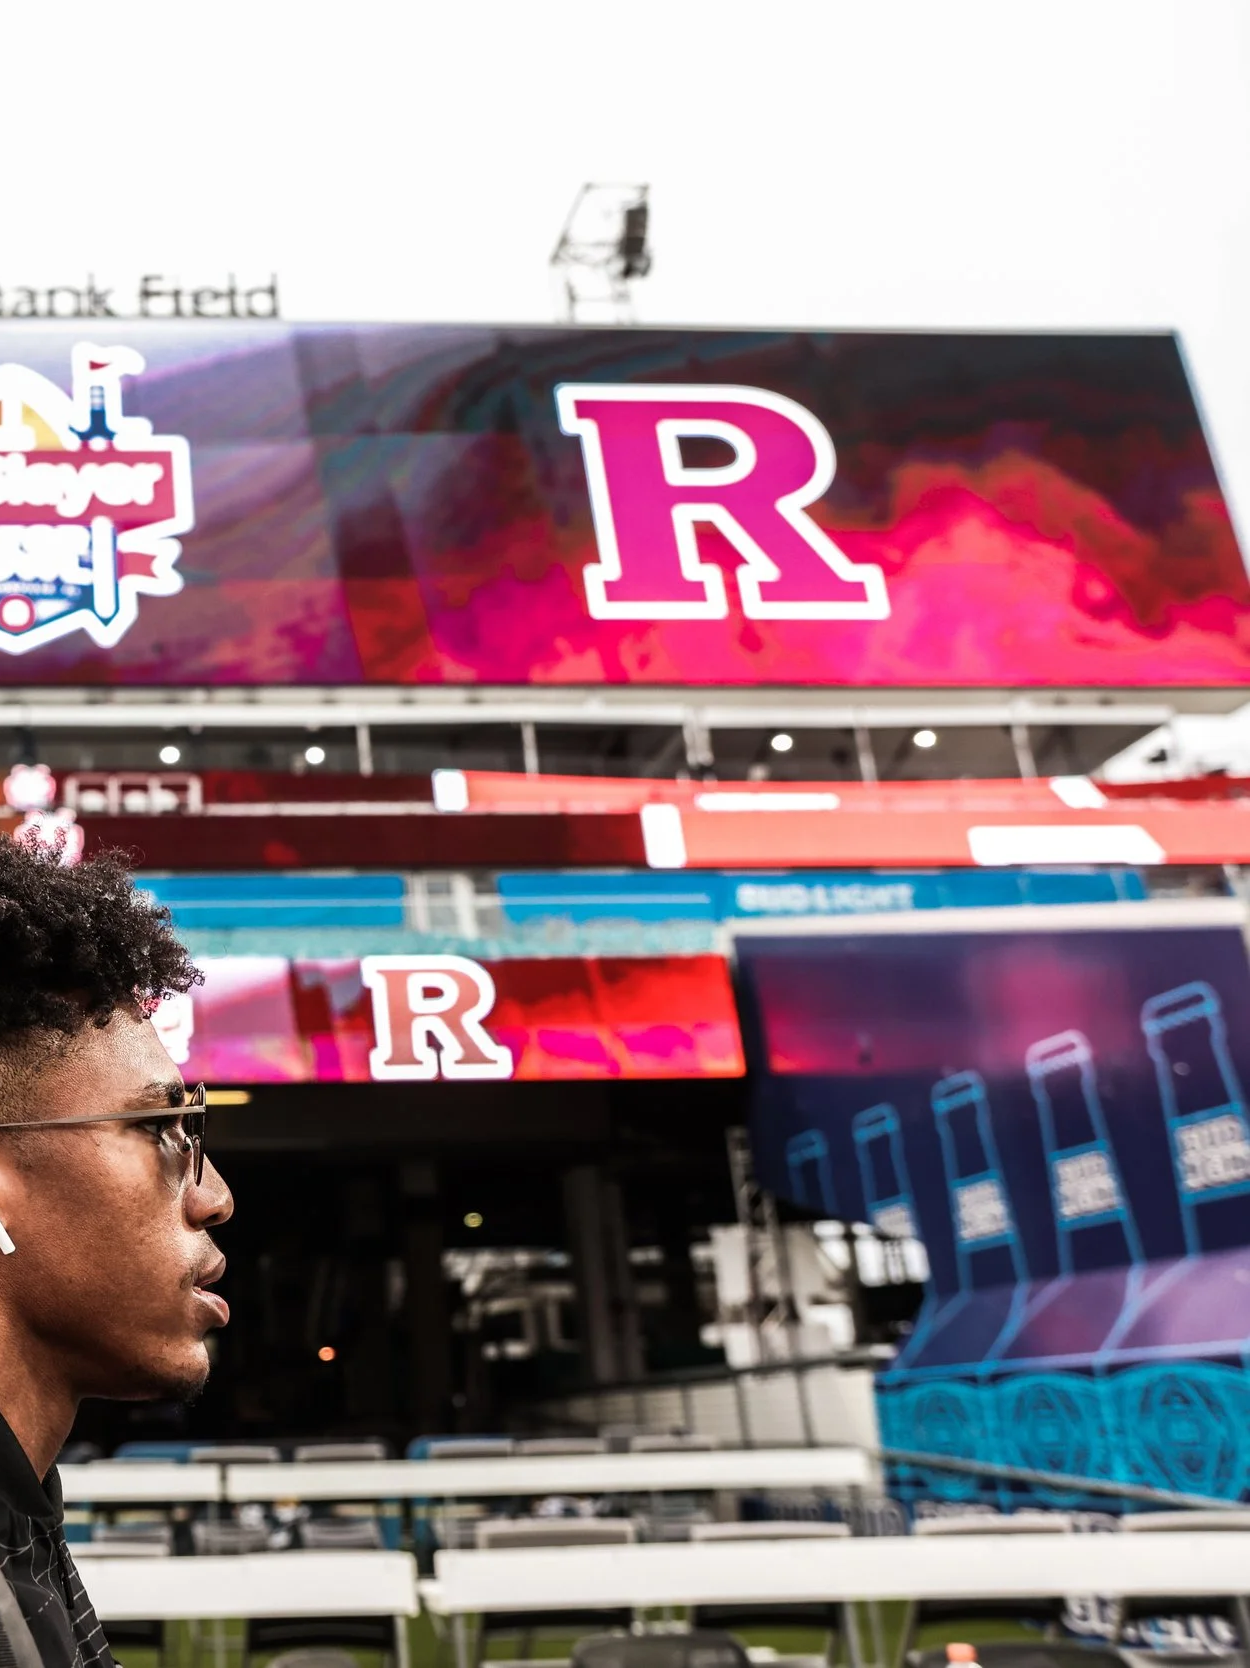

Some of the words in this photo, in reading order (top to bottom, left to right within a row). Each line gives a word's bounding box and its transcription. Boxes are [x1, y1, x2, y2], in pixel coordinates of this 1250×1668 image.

[138, 272, 281, 319] Field
[554, 382, 891, 620] R
[361, 954, 513, 1081] R
